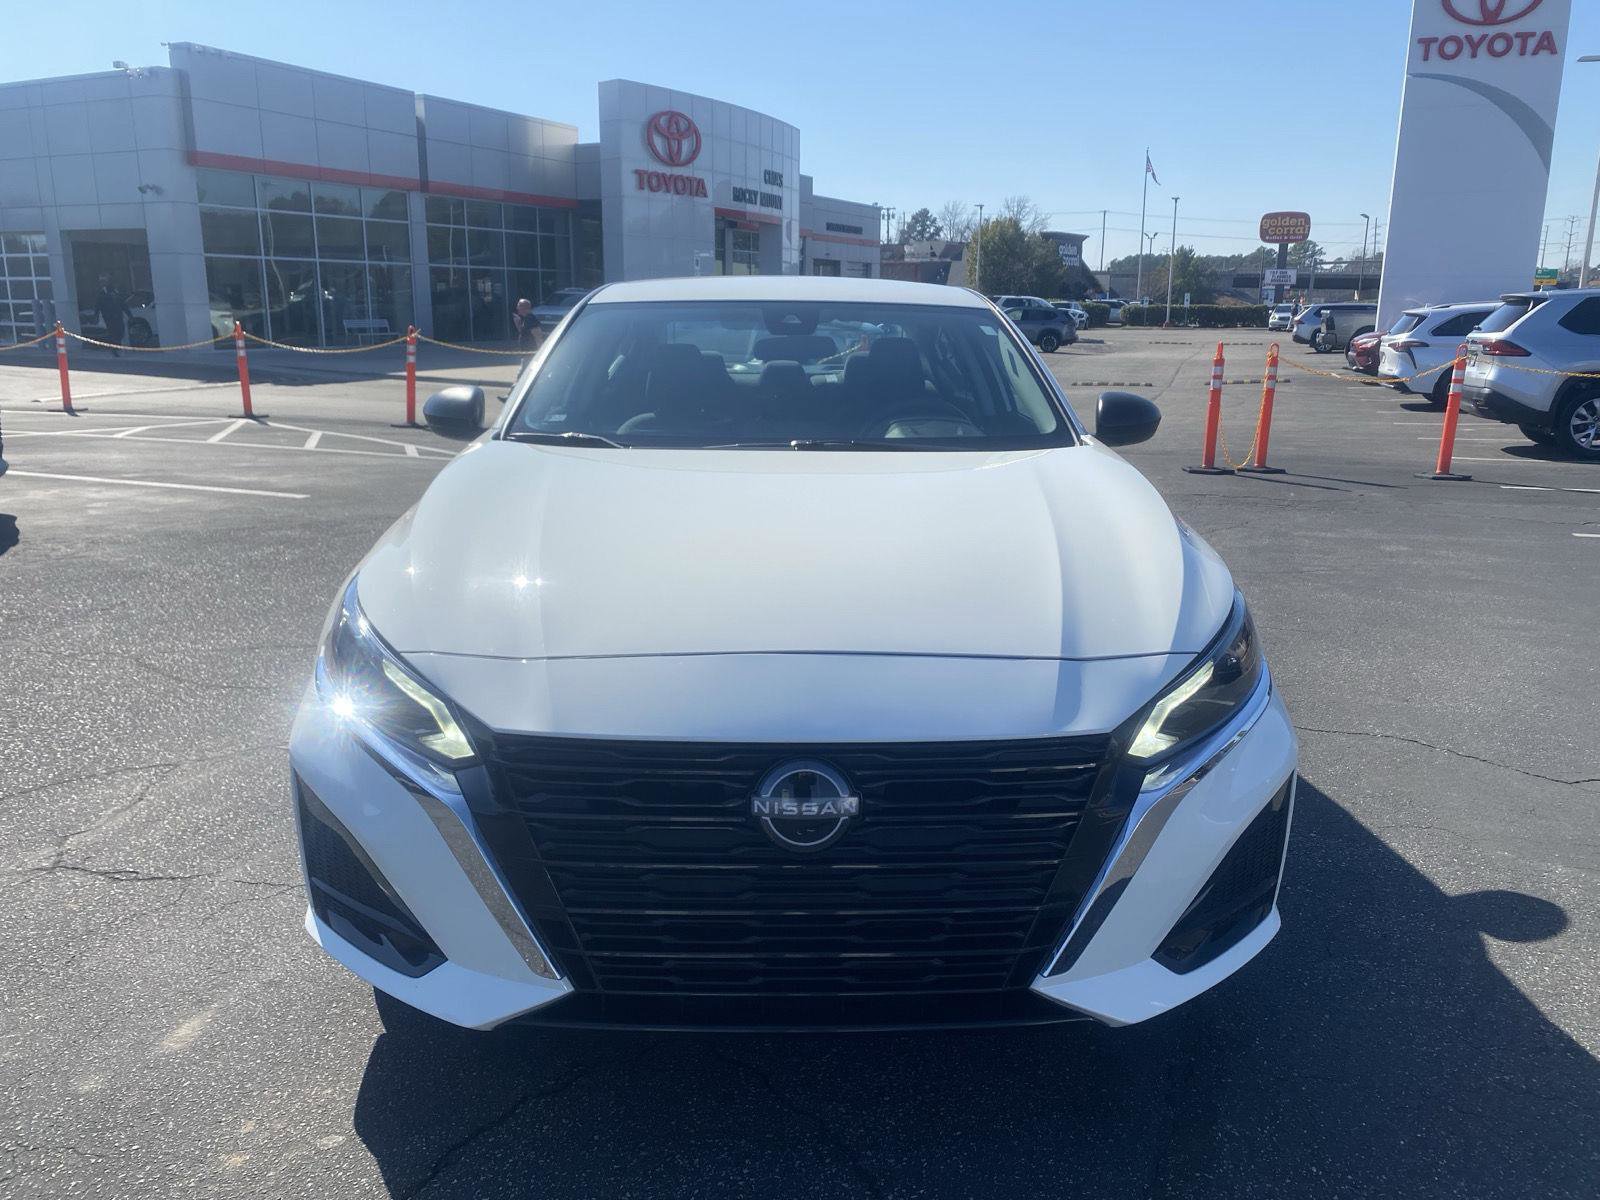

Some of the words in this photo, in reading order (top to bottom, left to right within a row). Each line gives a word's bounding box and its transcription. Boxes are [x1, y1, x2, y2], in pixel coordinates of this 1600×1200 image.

[1417, 31, 1557, 61] TOYOTA
[633, 169, 708, 198] TOYOTA
[1262, 216, 1305, 229] golden
[754, 799, 858, 816] NISSAN
